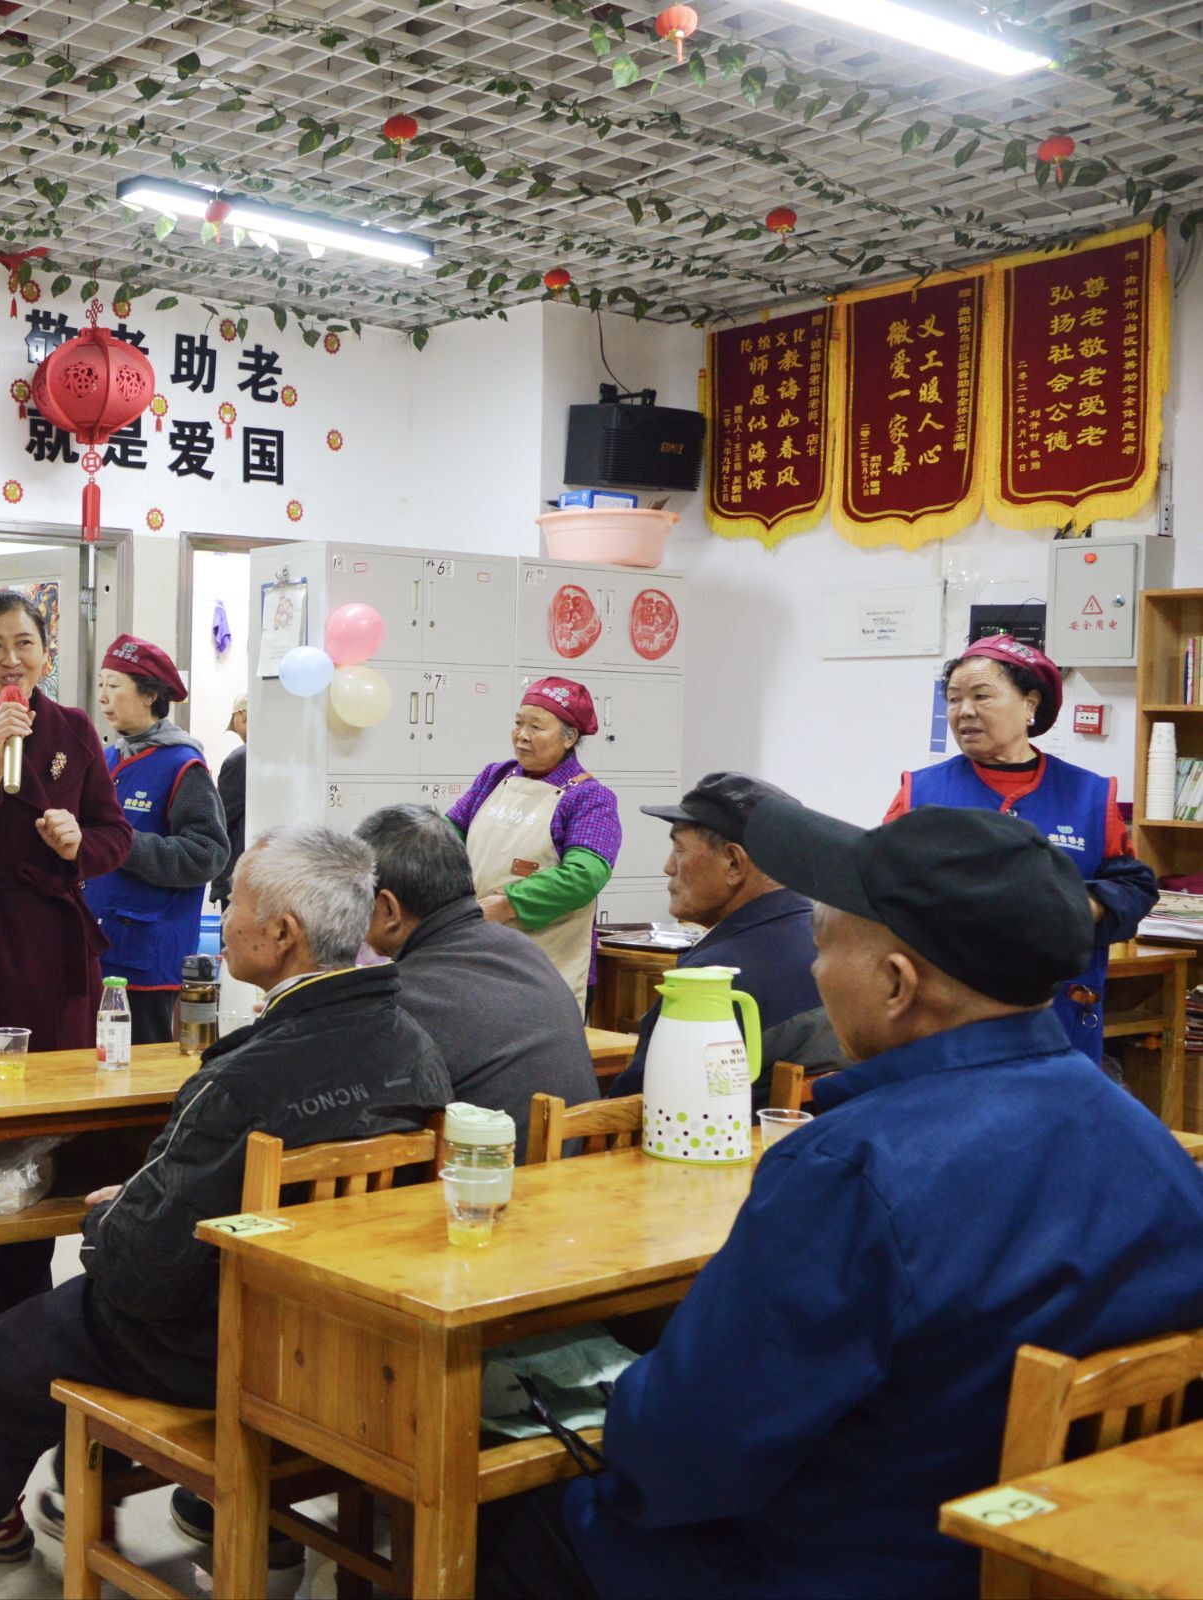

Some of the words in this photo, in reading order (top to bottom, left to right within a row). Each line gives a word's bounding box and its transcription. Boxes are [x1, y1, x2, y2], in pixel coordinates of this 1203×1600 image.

[741, 328, 806, 353] 传统文化
[886, 318, 915, 477] 微爱一家亲
[916, 313, 945, 466] 义工暖人心
[1043, 284, 1075, 453] 弘扬社会公德
[1076, 276, 1109, 447] 尊老敬老爱老
[747, 353, 770, 491] 师恩似海深
[776, 349, 804, 488] 教诲如春风
[1069, 619, 1117, 631] 安全用电
